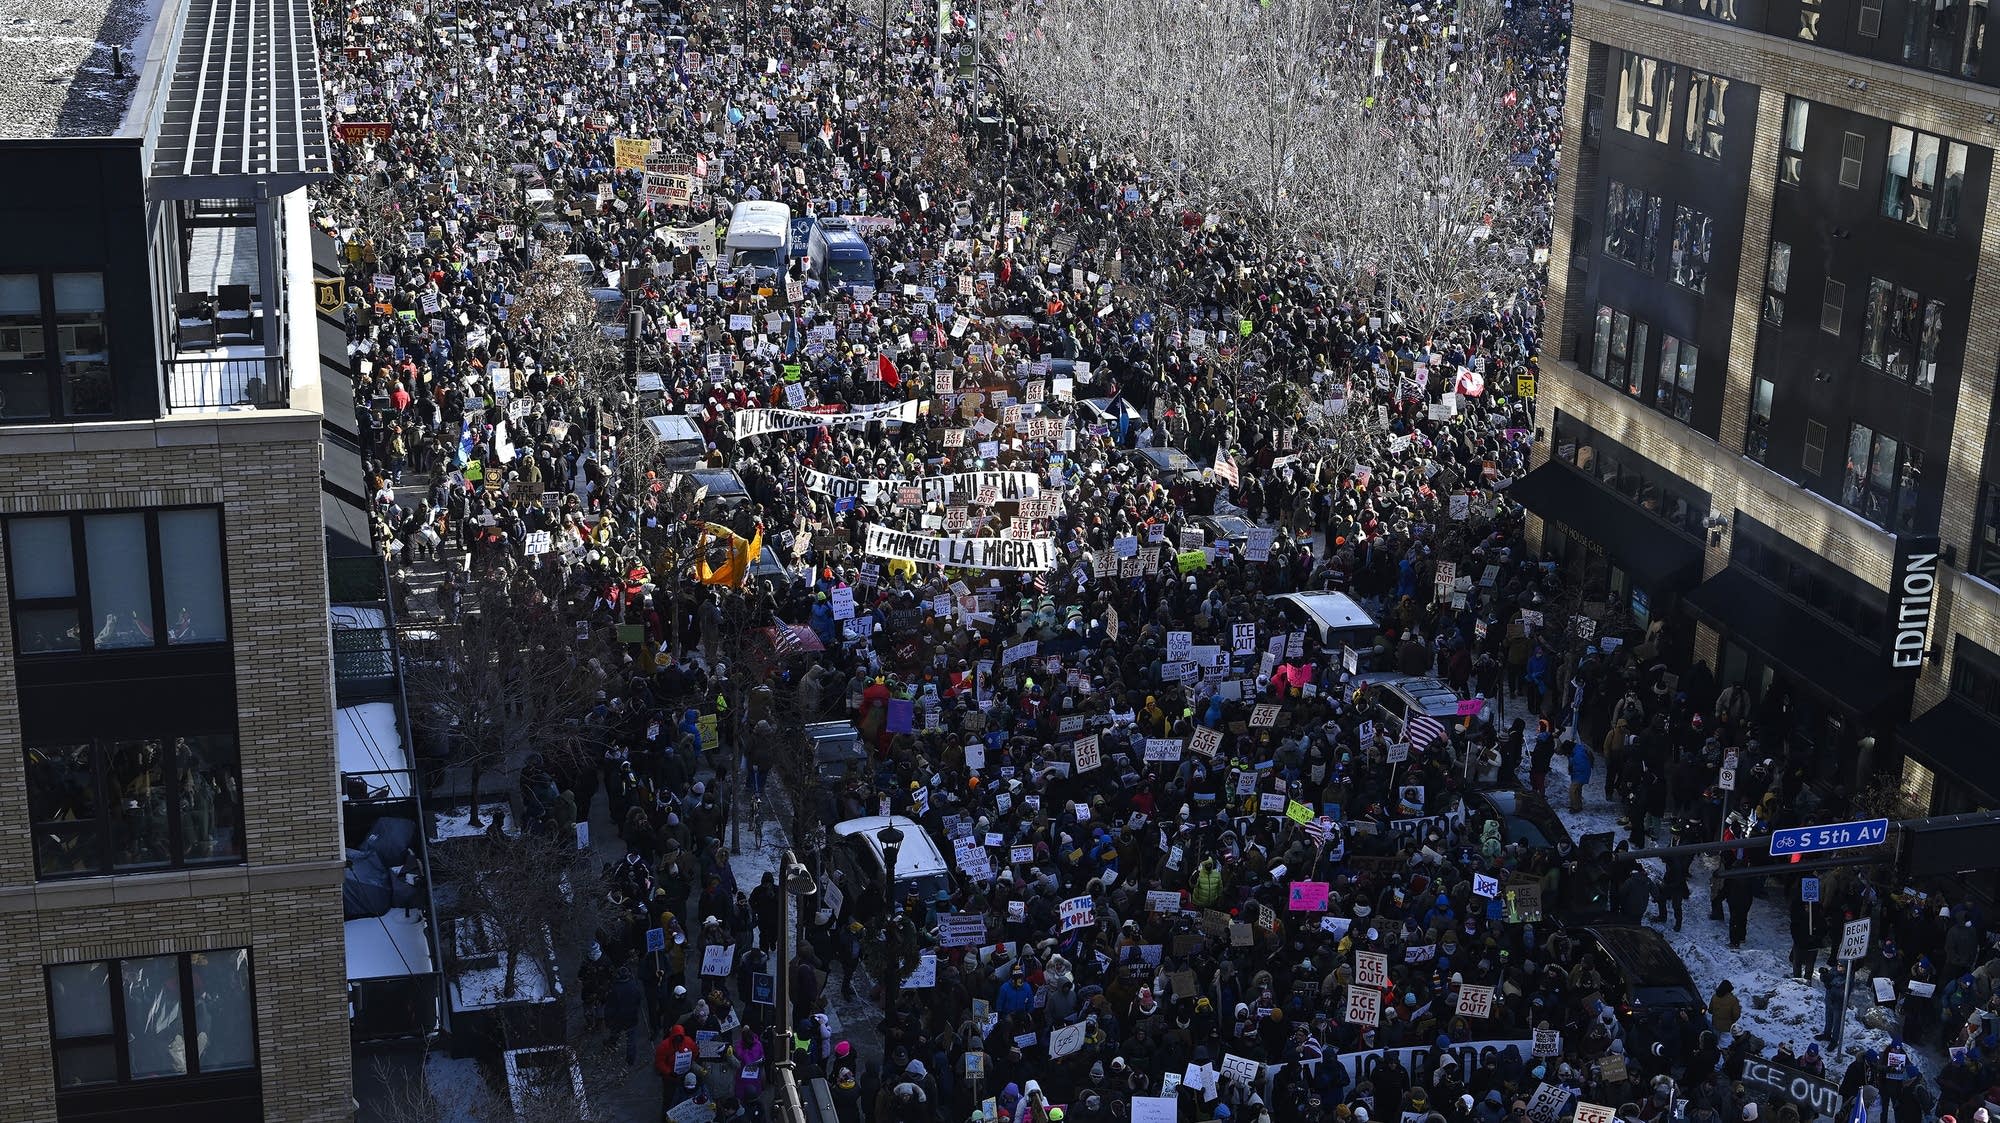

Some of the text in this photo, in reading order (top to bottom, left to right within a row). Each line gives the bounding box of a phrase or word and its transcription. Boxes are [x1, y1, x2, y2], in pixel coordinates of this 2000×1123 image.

[346, 128, 386, 136] WELLS
[648, 177, 687, 189] KILLER ICE
[647, 186, 656, 194] OFF
[657, 187, 666, 195] OUR
[857, 224, 874, 233] LOVE
[760, 341, 772, 350] BYE
[762, 349, 778, 360] NOW!
[937, 375, 950, 383] ICE
[791, 400, 806, 409] GOOD
[740, 410, 754, 435] NO
[1005, 415, 1019, 423] OUT!
[1030, 420, 1045, 429] ICE
[1048, 428, 1064, 437] OUT!
[517, 485, 534, 493] ICE
[820, 473, 870, 500] MORE
[542, 493, 558, 501] STOP
[979, 489, 995, 497] ICE
[1031, 503, 1046, 511] ICE
[948, 511, 964, 520] ICE
[948, 520, 965, 529] OUT!
[1013, 521, 1028, 531] ICE
[531, 534, 547, 543] ICE
[1013, 530, 1029, 539] OUT!
[528, 543, 547, 554] OUT
[949, 540, 974, 565] LA
[1100, 554, 1114, 562] ICE
[1438, 566, 1453, 575] ICE
[1437, 574, 1453, 583] OUT!
[1892, 553, 1938, 668] EDITION
[845, 619, 862, 627] ICE
[1170, 633, 1186, 641] ICE
[1235, 625, 1254, 638] ICE
[1234, 638, 1254, 650] OUT
[1216, 655, 1226, 665] ICE
[1180, 661, 1198, 673] STOP
[1205, 666, 1223, 674] STOP
[1254, 709, 1273, 717] ICE
[1252, 717, 1273, 725] OUT!
[1195, 731, 1217, 744] ICE
[1077, 744, 1096, 757] ICE
[1193, 740, 1215, 755] OUT!
[1078, 755, 1096, 768] OUT!
[1800, 826, 1882, 848] S 5th Av
[963, 847, 983, 859] STOP
[1518, 888, 1530, 896] ICE
[1060, 897, 1092, 913] WE THE
[1847, 923, 1869, 936] BEGIN
[941, 936, 985, 945] EVERYWHERE
[1847, 934, 1865, 947] ONE
[707, 949, 717, 957] MN
[1843, 945, 1864, 957] WAY
[704, 965, 715, 973] NO
[1359, 959, 1383, 974] ICE
[1358, 970, 1385, 986] OUT!
[1352, 995, 1375, 1010] ICE
[1461, 992, 1487, 1004] ICE
[1460, 1002, 1487, 1015] OUT!
[1350, 1009, 1377, 1024] OUT!
[1224, 1057, 1253, 1075] ICE
[1743, 1059, 1839, 1113] ICE OUT
[1543, 1084, 1567, 1100] ICE
[1538, 1094, 1563, 1108] OUT
[1534, 1102, 1556, 1116] FOR
[1527, 1109, 1553, 1123] GOOD
[1578, 1112, 1607, 1123] ICE
